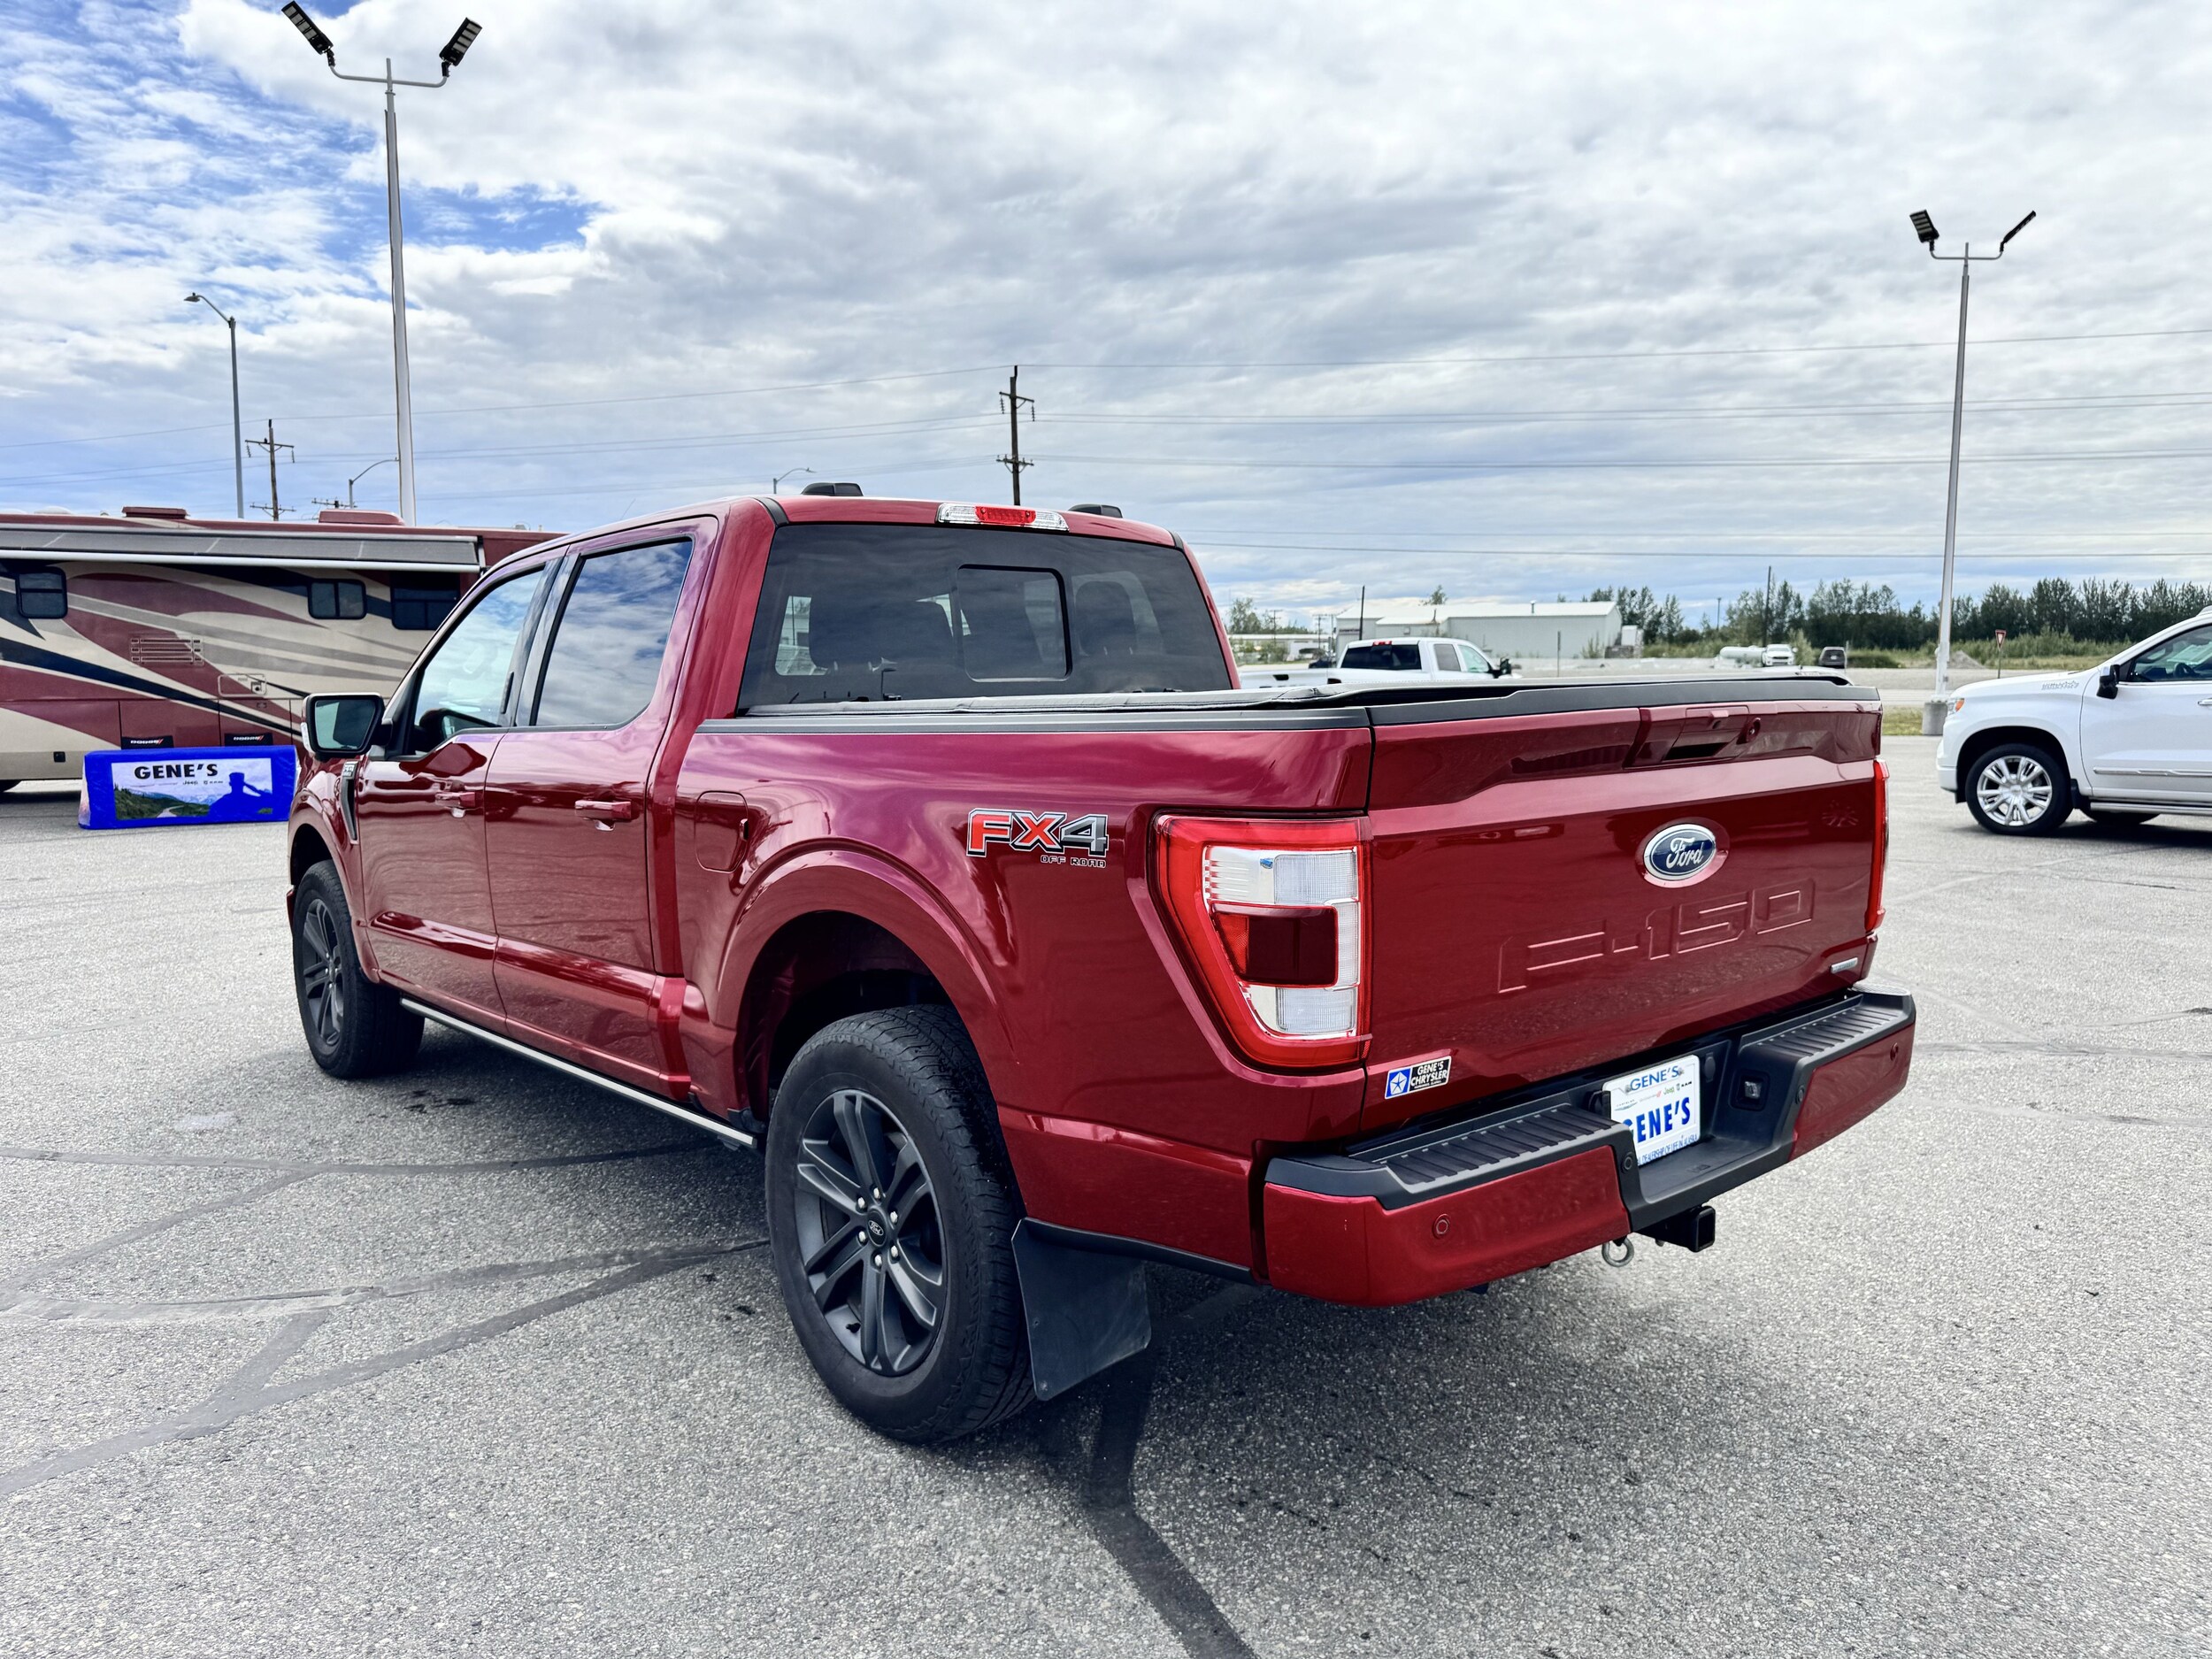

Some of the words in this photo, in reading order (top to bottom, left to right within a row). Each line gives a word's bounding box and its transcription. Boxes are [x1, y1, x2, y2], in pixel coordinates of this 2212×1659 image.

[134, 764, 219, 780] GENE'S
[966, 808, 1109, 857] FX4
[1041, 855, 1066, 864] OFF
[1071, 856, 1106, 869] ROAD
[1666, 836, 1704, 869] Ford
[1498, 877, 1814, 994] F-150
[1410, 1069, 1448, 1087] CHRYSLER
[1417, 1061, 1444, 1076] GENE'S
[1630, 1065, 1679, 1091] GENE'S
